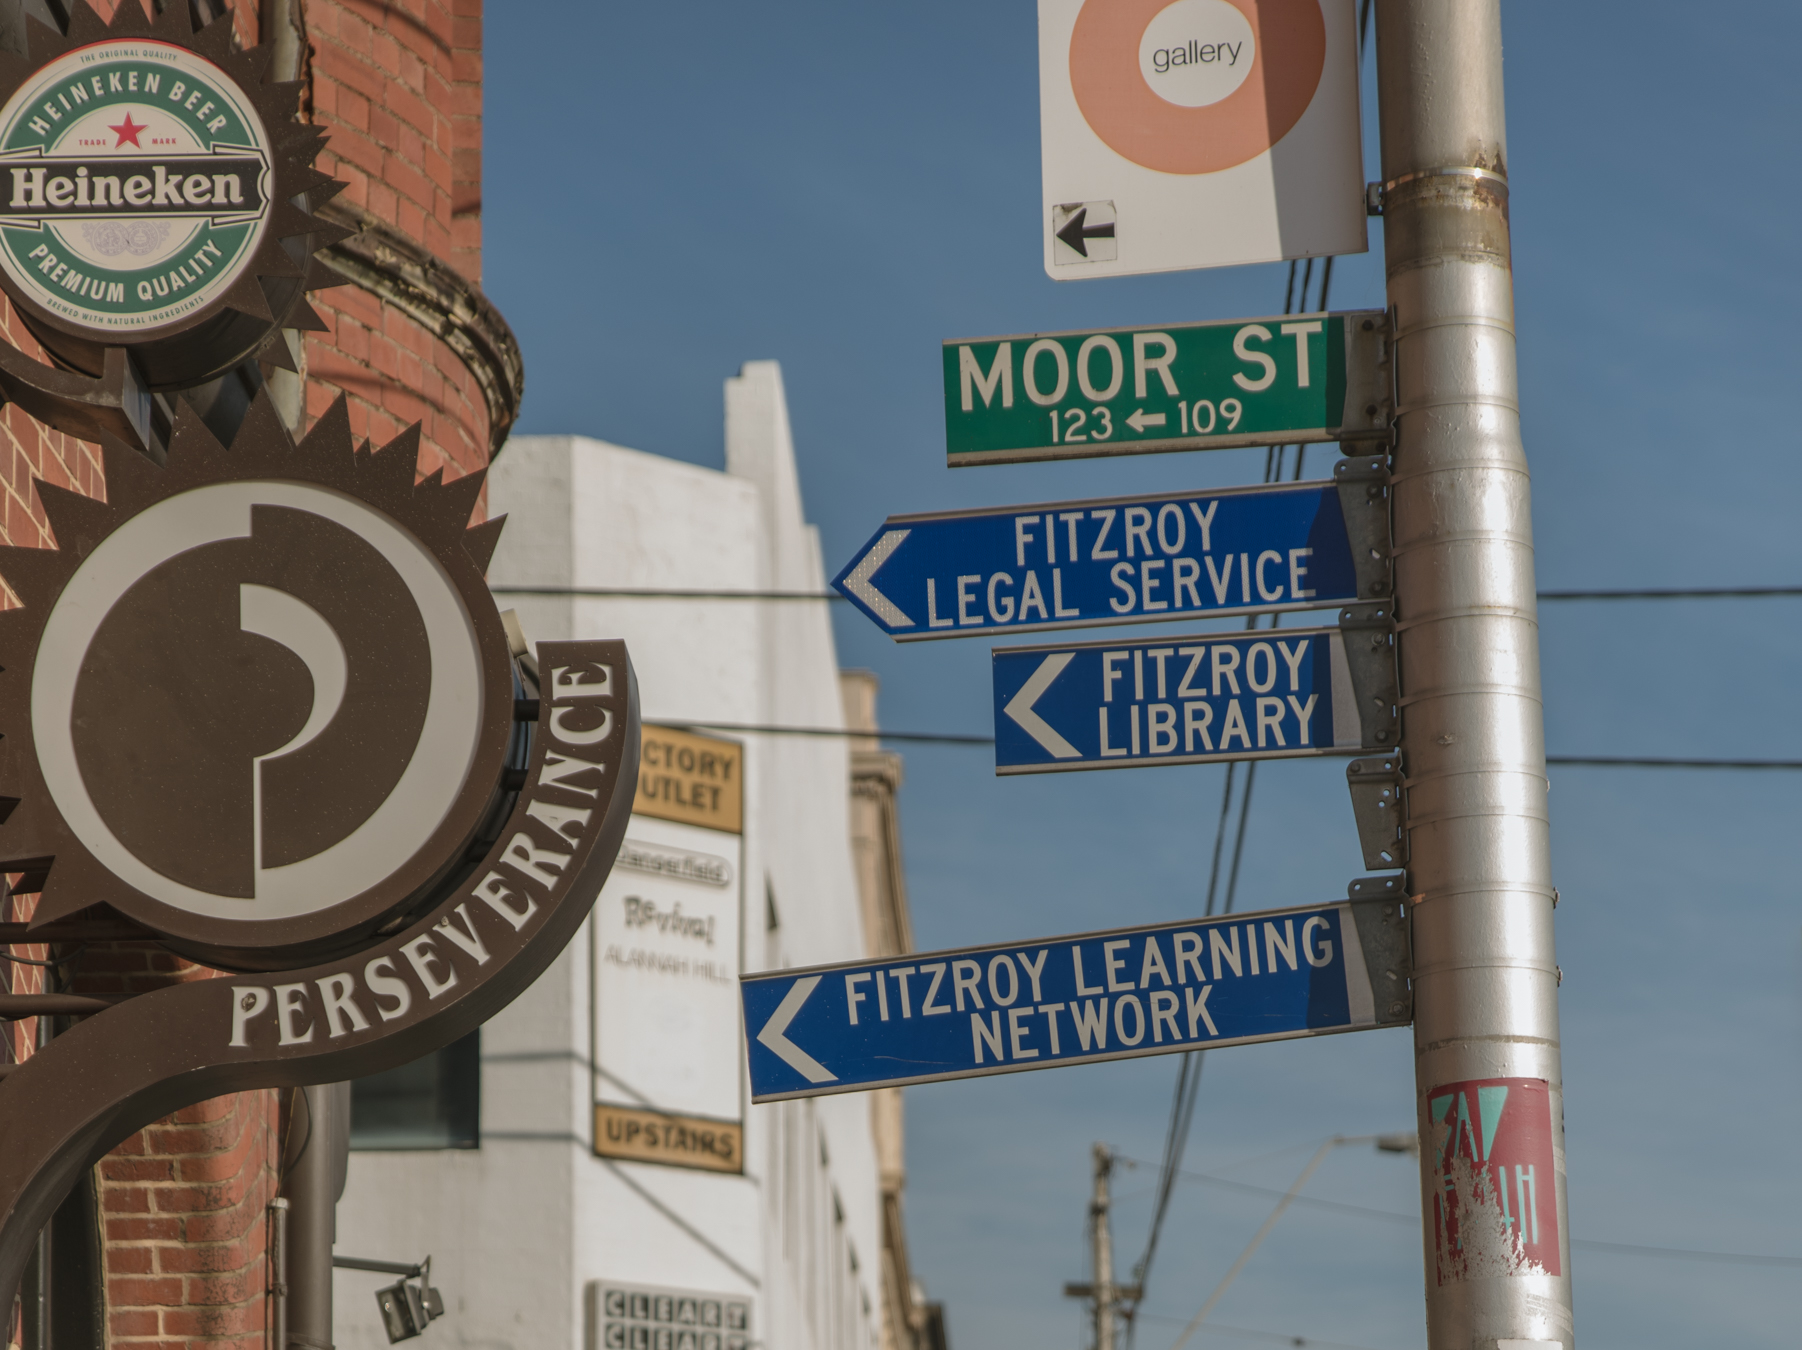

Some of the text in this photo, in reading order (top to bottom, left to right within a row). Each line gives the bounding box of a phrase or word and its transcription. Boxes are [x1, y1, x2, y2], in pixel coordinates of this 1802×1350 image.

[80, 49, 178, 63] THE ORIGINAL QUALITY
[1153, 39, 1242, 73] gallery
[28, 71, 227, 136] HEINEKEN BEER
[78, 137, 177, 146] TRADE MARK
[9, 165, 244, 207] Heineken
[28, 239, 224, 303] PREMIUM QUALITY
[46, 295, 204, 325] BREWED WITH NATURAL INGREDIENTS
[958, 321, 1323, 412] MOOR ST
[1049, 398, 1243, 442] 123 109
[1015, 500, 1219, 567] FITZROY
[927, 547, 1317, 628] LEGAL SERVICE
[1102, 639, 1310, 702] FITZROY
[1099, 694, 1319, 757] LIBRARY
[643, 740, 734, 780] CTORY
[641, 773, 722, 812] UTLET
[229, 661, 614, 1047] PERSEVERANCE
[624, 895, 716, 947] Revival
[844, 916, 1334, 1025] FITZROY LEARNING
[970, 985, 1219, 1064] NETWORK
[606, 1116, 735, 1158] UPSTAIRS
